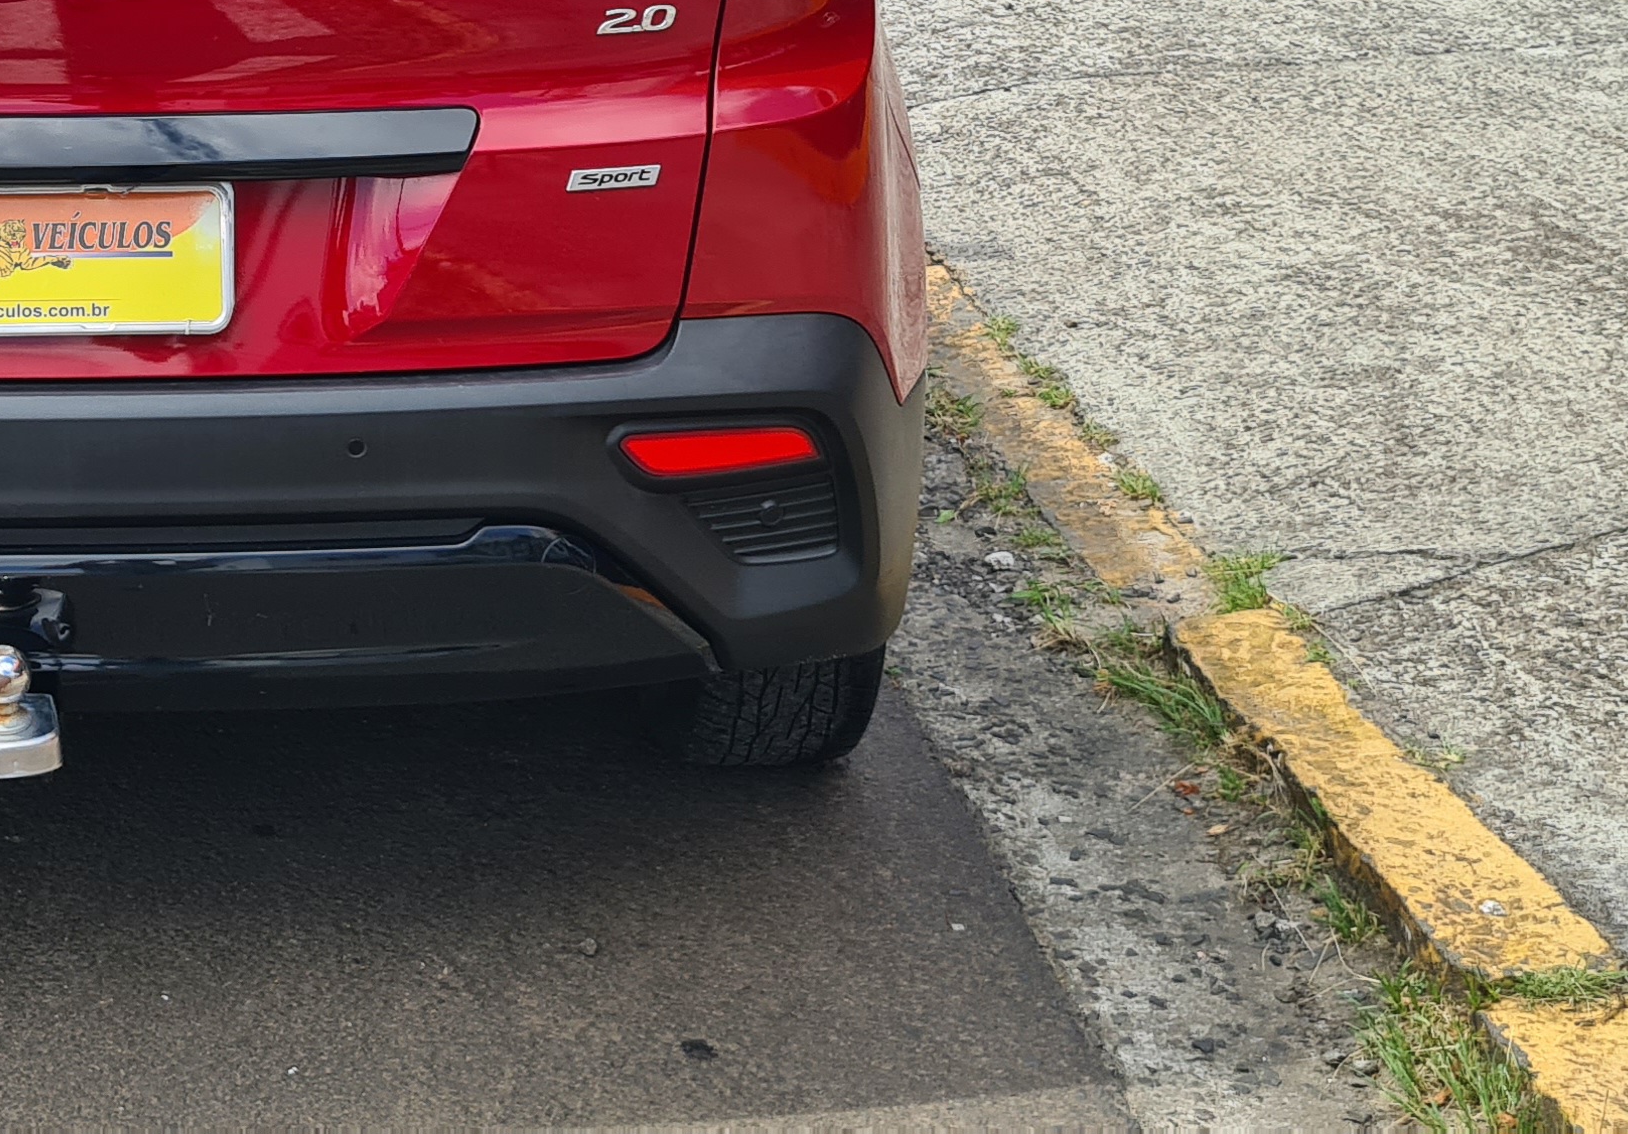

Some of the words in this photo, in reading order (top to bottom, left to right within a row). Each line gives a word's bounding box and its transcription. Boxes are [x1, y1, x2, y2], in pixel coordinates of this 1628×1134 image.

[596, 4, 677, 35] 2.0
[577, 169, 652, 187] Sport
[31, 211, 173, 251] VEÍCULOS
